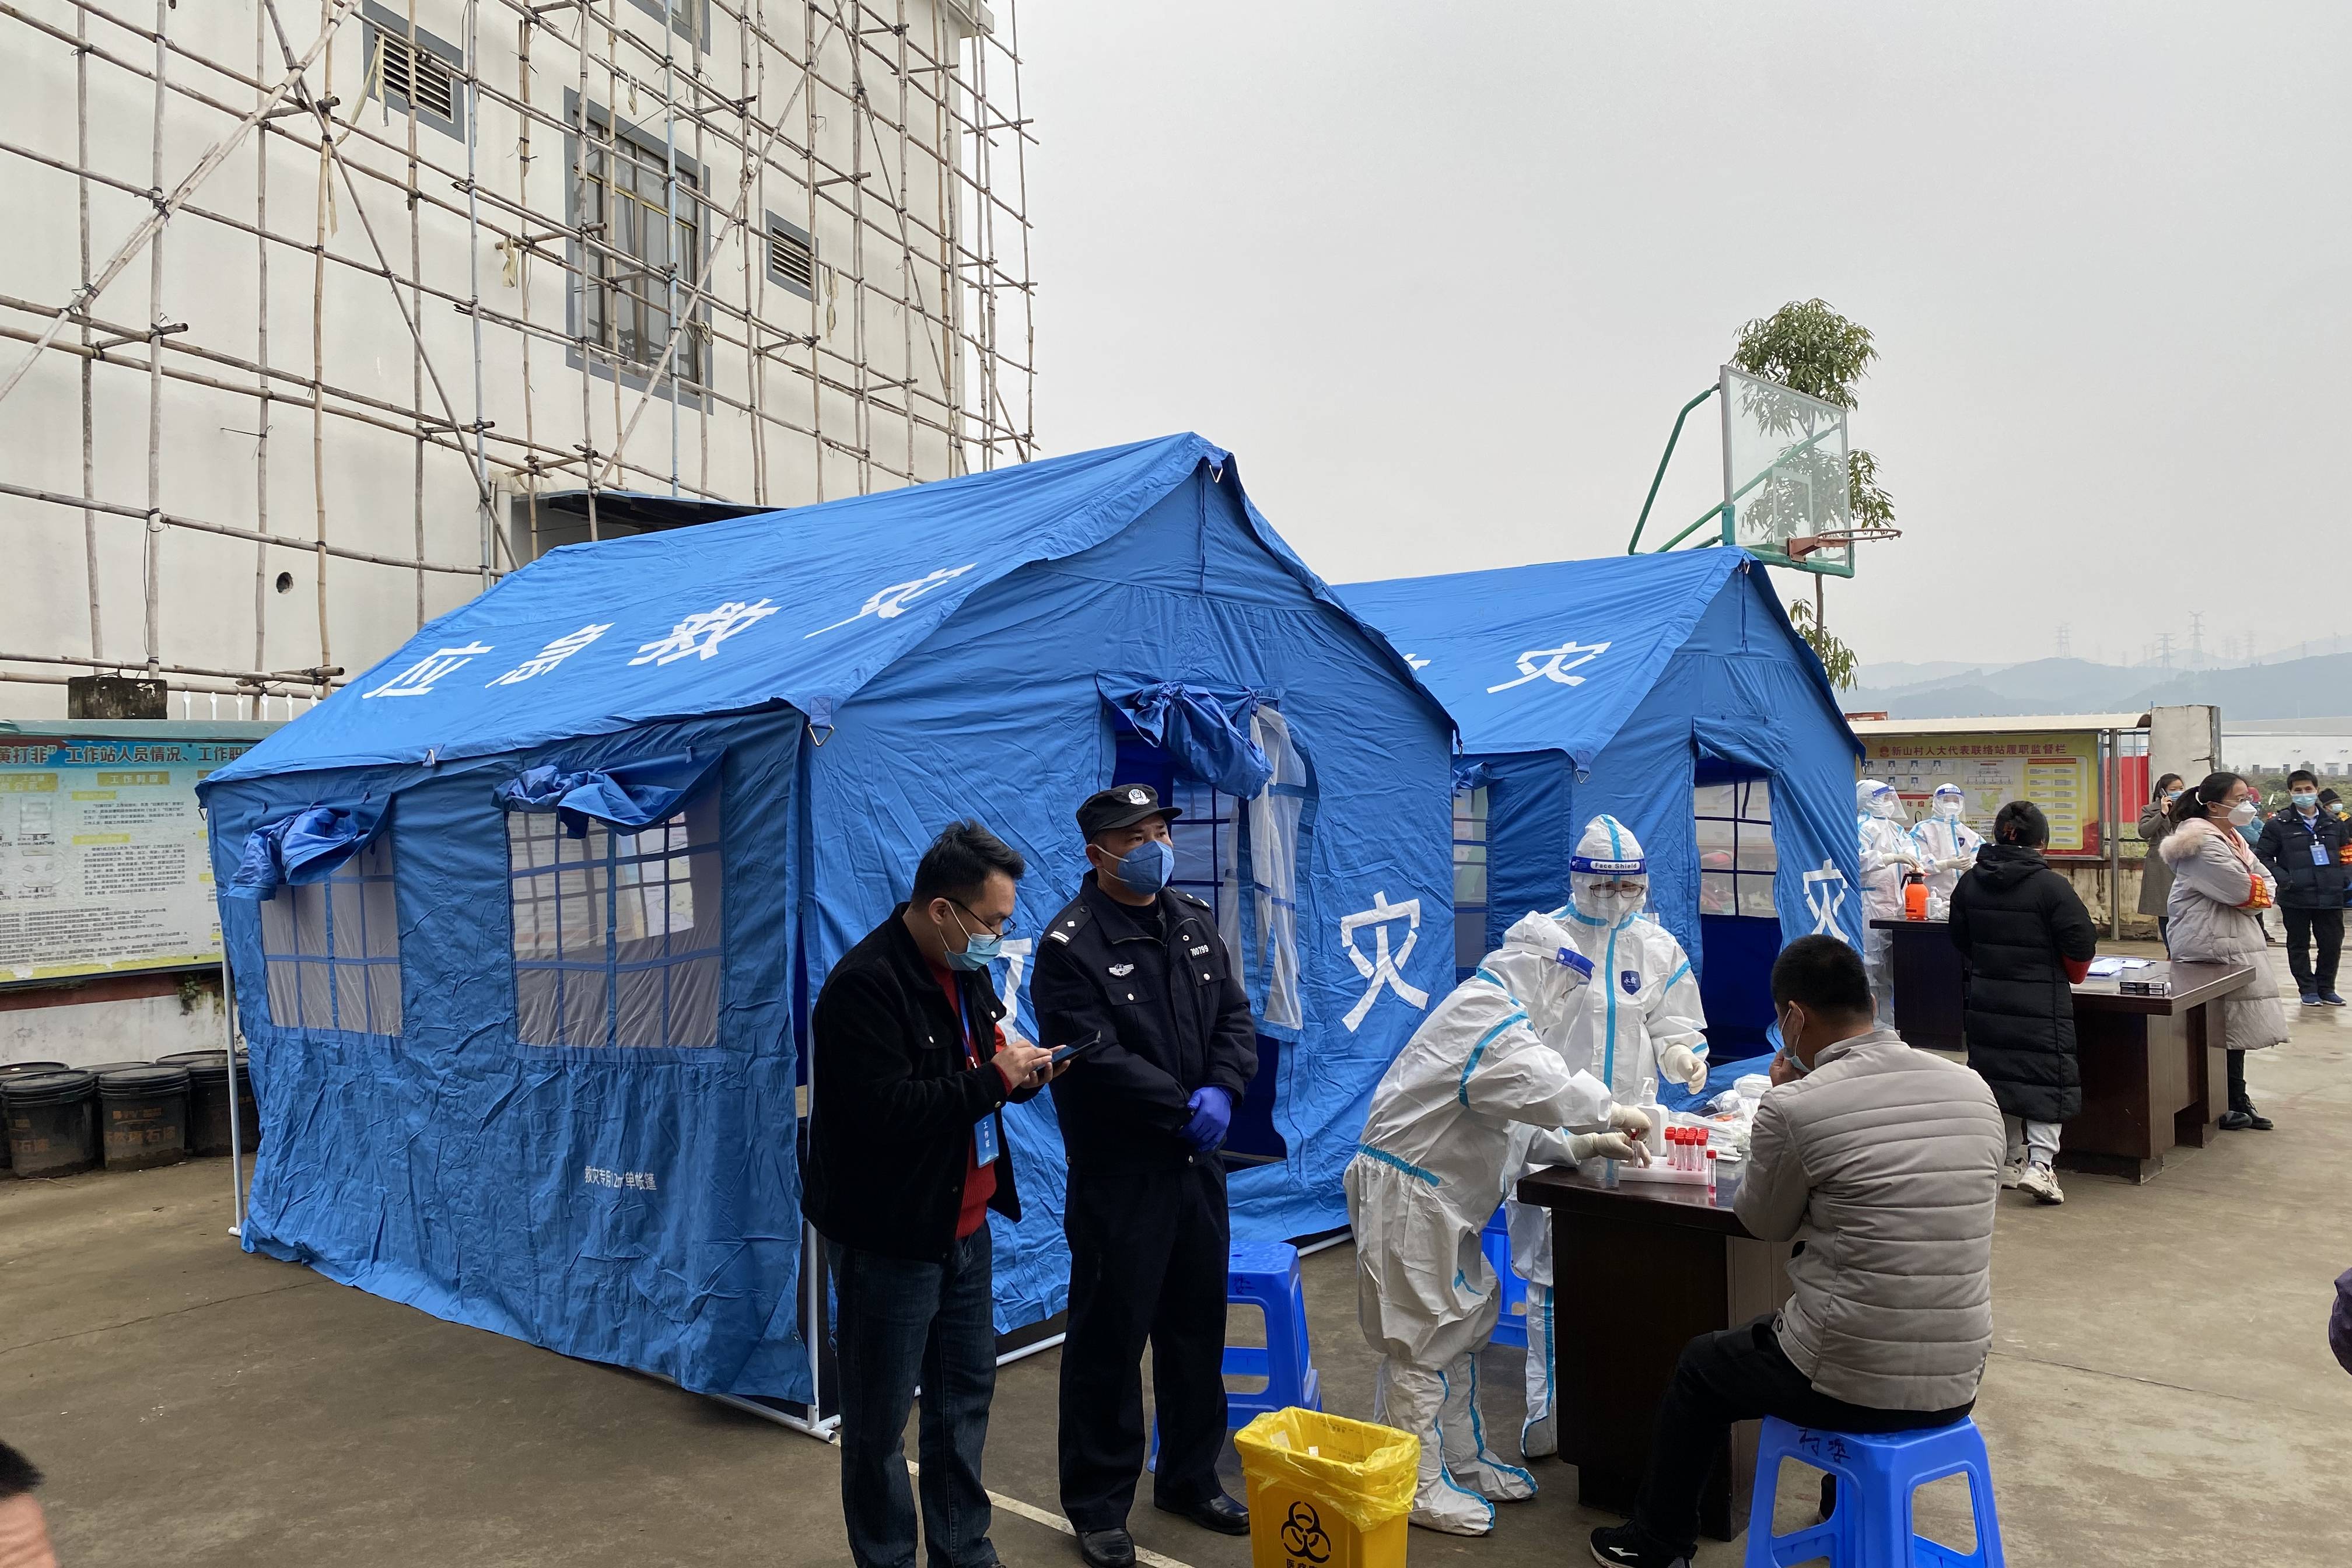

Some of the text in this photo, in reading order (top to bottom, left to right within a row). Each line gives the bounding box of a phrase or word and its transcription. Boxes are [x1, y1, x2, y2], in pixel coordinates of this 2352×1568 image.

[1486, 641, 1612, 694] 灾
[0, 745, 254, 764] 黄打非”工作站人员情况、工作职
[1891, 744, 2067, 757] 新山村人大代表联络站履职监督栏
[1803, 858, 1850, 944] 灾
[1341, 891, 1430, 1032] 灾
[584, 1166, 657, 1191] 救灾专用12m单帐篷
